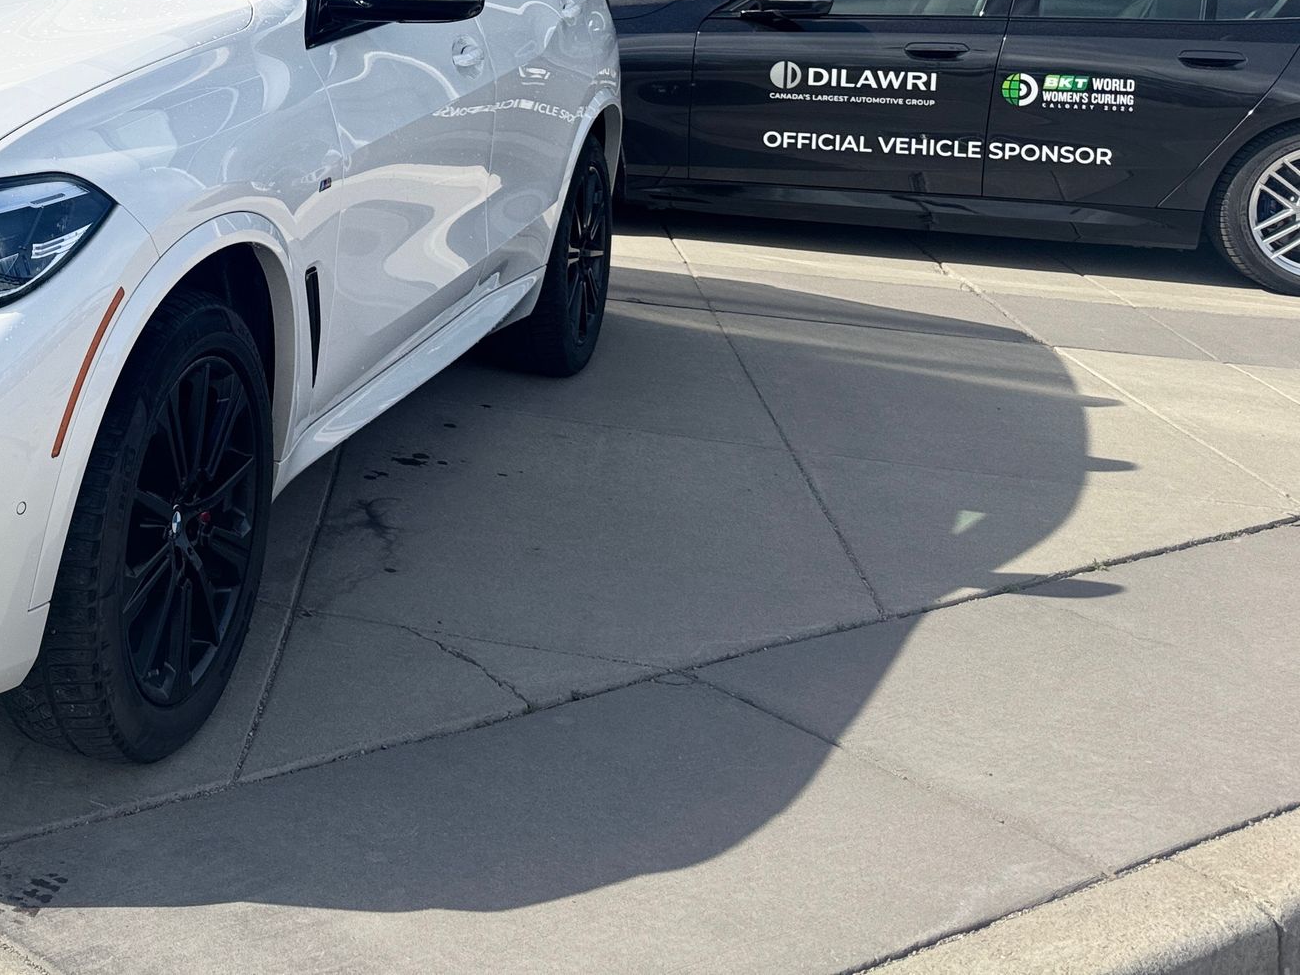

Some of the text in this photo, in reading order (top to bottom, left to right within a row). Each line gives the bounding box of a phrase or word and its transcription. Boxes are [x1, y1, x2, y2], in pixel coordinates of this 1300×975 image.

[807, 67, 938, 92] DILAWRI
[1044, 77, 1136, 92] BKT WORLD
[769, 92, 936, 106] CANADA'S LARGEST AUTOMOTIVE GROUP
[1042, 90, 1135, 106] WOMEN'S CURLING
[762, 130, 1113, 166] OFFICIAL VEHICLE SPONSOR
